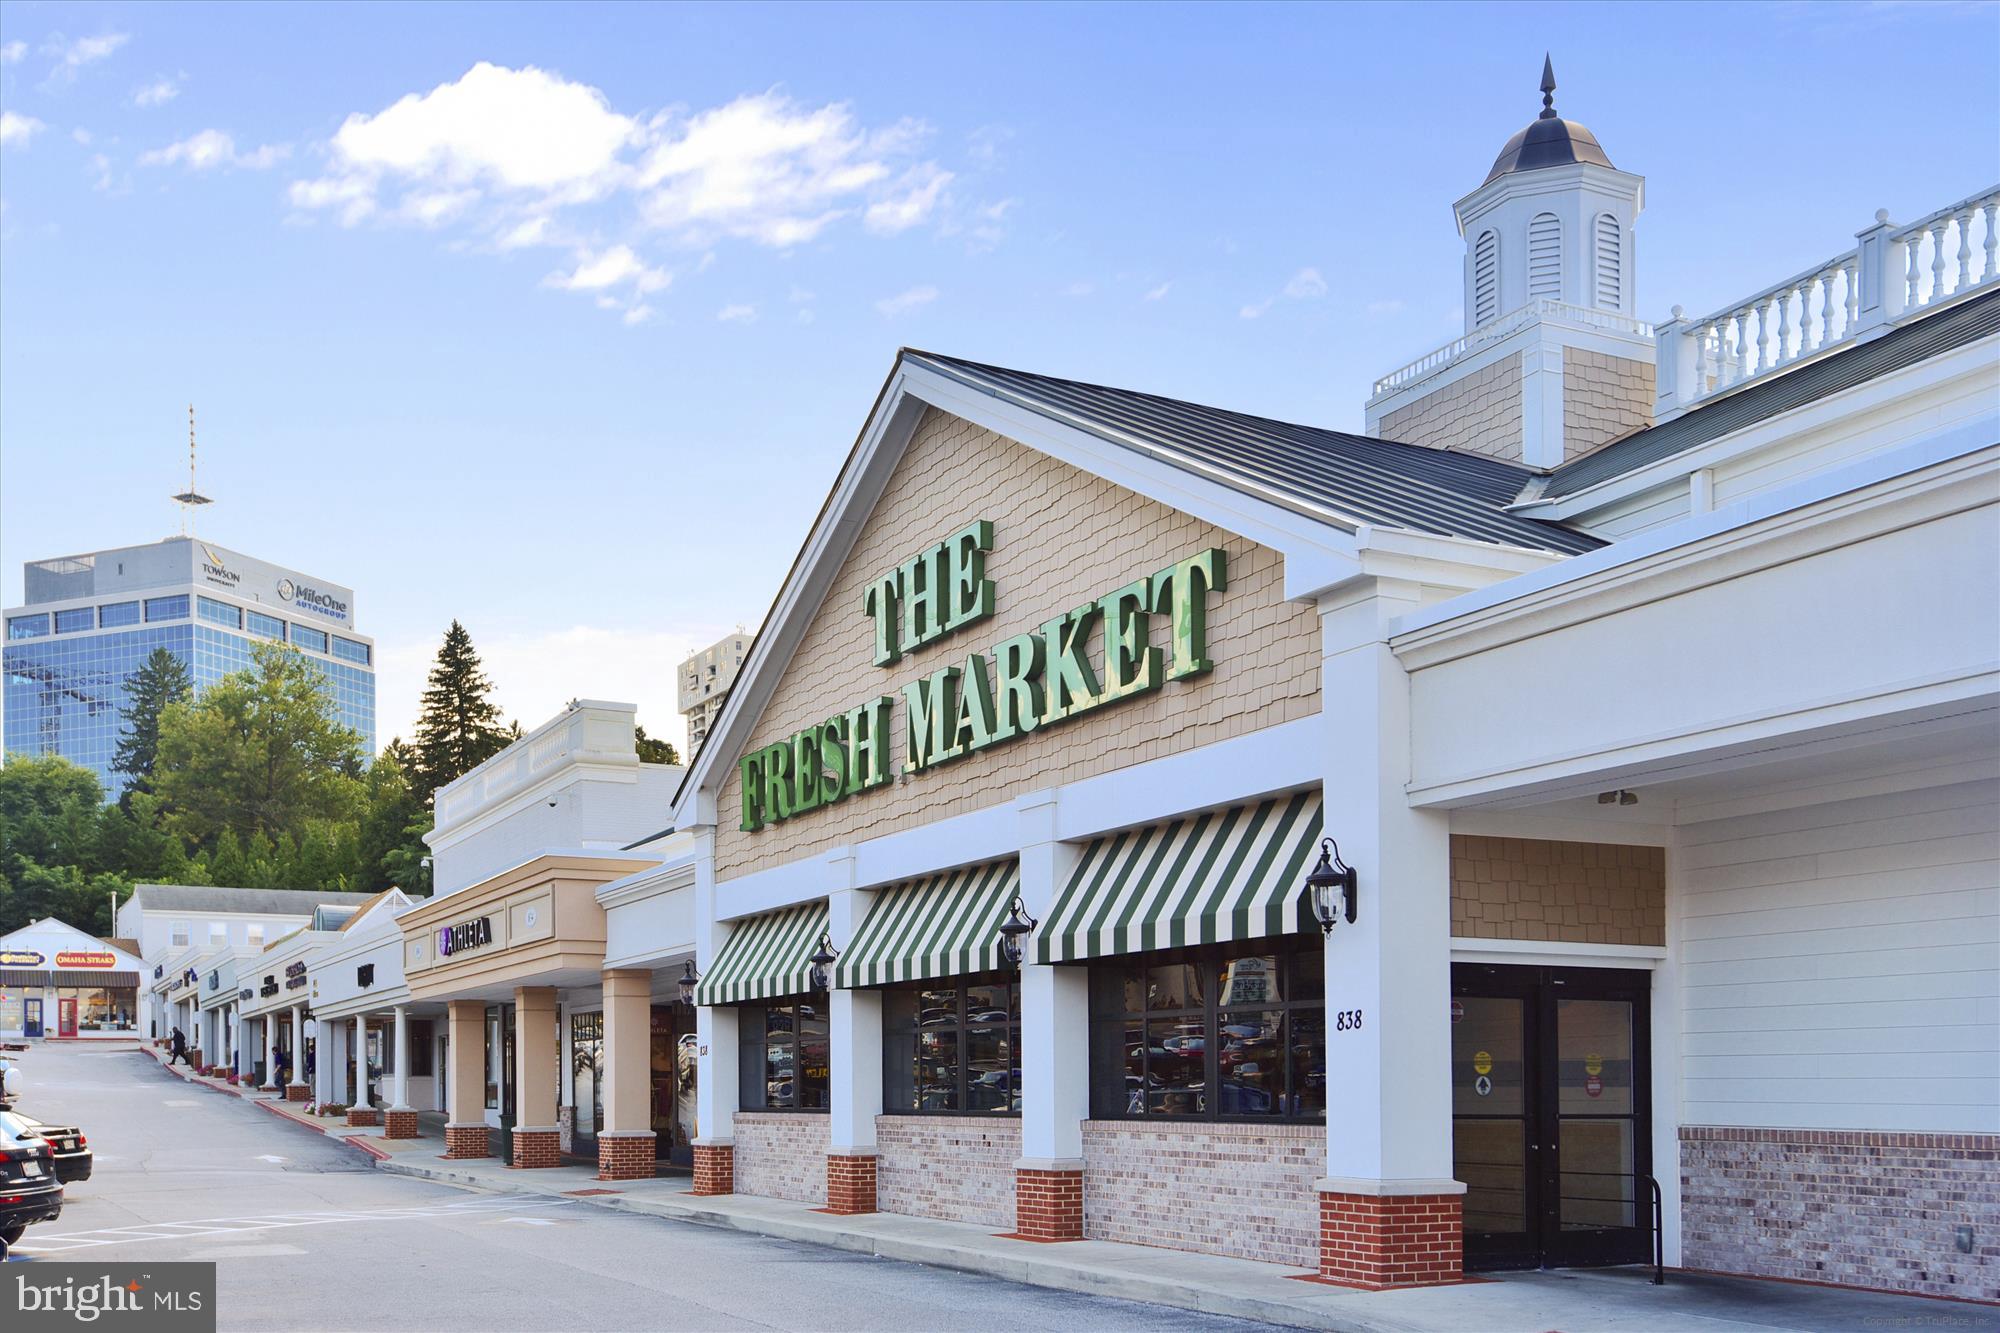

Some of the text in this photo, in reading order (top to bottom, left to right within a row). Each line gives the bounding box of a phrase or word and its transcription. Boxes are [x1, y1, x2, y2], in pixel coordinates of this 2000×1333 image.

[202, 563, 240, 582] TOWSON
[296, 585, 347, 612] MileOne
[863, 519, 995, 668] THE
[296, 600, 346, 620] AUTOGROUP
[738, 547, 1228, 832] FRESH MARKET
[447, 917, 492, 955] ATHLETA
[57, 956, 86, 964] OMAHA
[1336, 1009, 1362, 1031] 838
